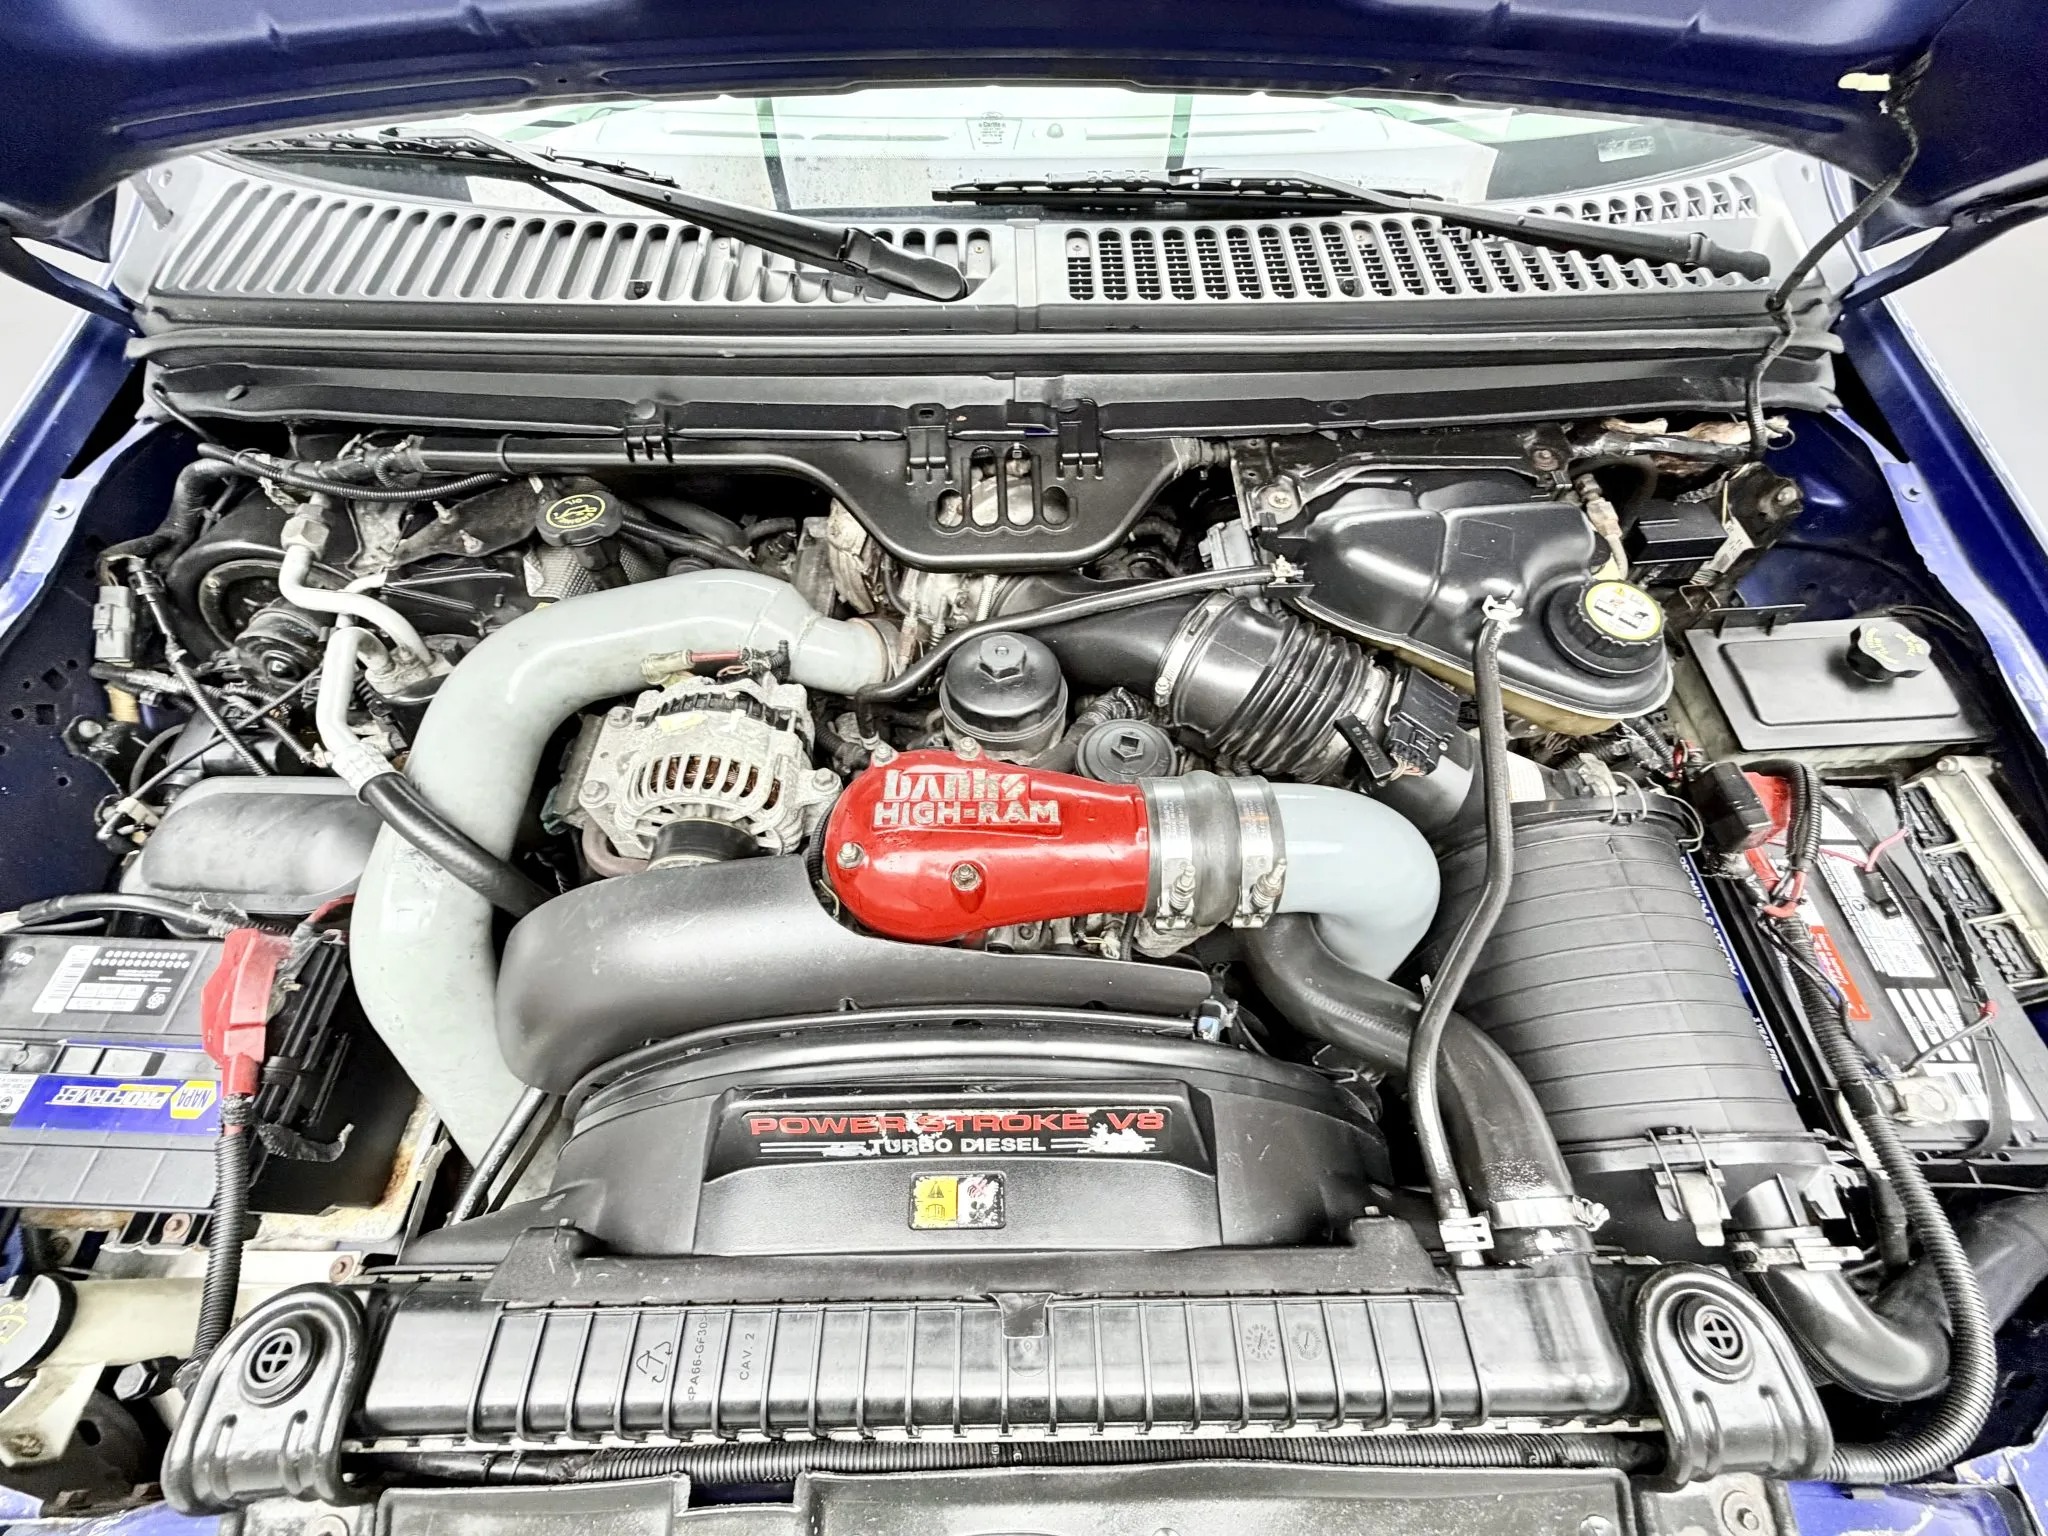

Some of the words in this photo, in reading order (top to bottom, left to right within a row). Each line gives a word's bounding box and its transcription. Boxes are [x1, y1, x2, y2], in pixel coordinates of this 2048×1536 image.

[873, 800, 1060, 826] HIGH-RAM
[1766, 1047, 1784, 1072] FREE
[53, 1087, 170, 1108] PROFORMER
[175, 1089, 210, 1108] NAPA
[750, 1116, 907, 1136] POWER
[916, 1114, 1090, 1133] STROKE
[1105, 1112, 1165, 1131] V8
[868, 1138, 954, 1155] TURBO
[960, 1137, 1047, 1152] DIESEL
[745, 1332, 755, 1341] 2
